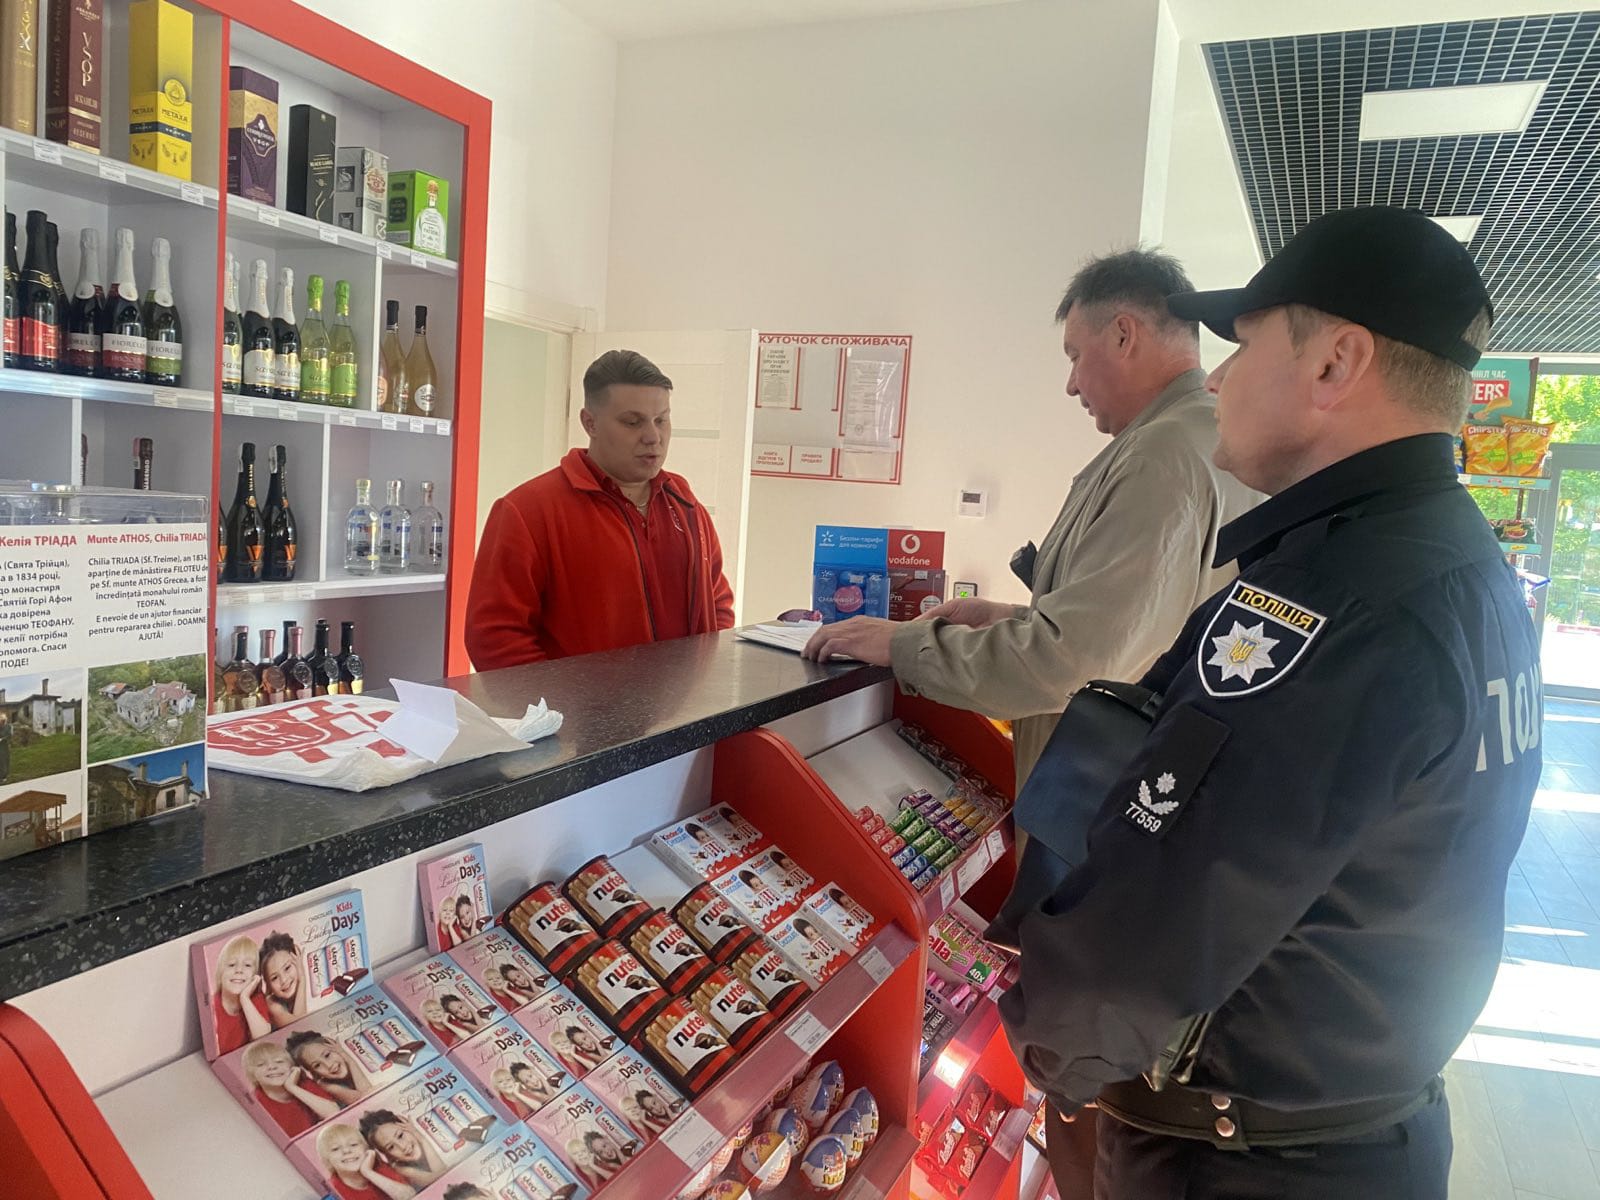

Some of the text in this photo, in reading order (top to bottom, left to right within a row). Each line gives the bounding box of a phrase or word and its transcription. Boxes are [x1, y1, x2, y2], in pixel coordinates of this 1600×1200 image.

[758, 335, 908, 346] КУТОЧОК СПОЖИВАЧА
[1473, 383, 1505, 401] ERS
[34, 535, 77, 547] ТРІАДА
[87, 534, 118, 544] Munte
[119, 534, 153, 543] ATHOS,
[154, 533, 179, 542] Chilia
[4, 560, 33, 570] (Свята
[88, 557, 110, 566] Chilia
[112, 556, 140, 564] TRIADA
[173, 564, 201, 572] FILOTEU
[888, 557, 931, 566] vodafone
[16, 572, 37, 581] 1834
[113, 579, 137, 587] munte
[138, 577, 162, 586] ATHOS
[11, 584, 61, 593] монастиря
[142, 587, 180, 596] monahului
[29, 595, 47, 606] Горі
[48, 595, 72, 604] Афон
[136, 599, 167, 608] TEOFAN.
[10, 608, 51, 619] довірена
[102, 613, 128, 622] nevoie
[129, 611, 139, 619] de
[140, 610, 149, 618] un
[150, 608, 171, 619] ajutor
[172, 606, 202, 616] financiar
[1237, 588, 1314, 630] ПОЛІЦІЯ
[31, 617, 75, 629] ТЕОФАНУ.
[88, 627, 115, 637] pentru
[116, 622, 151, 633] repararea
[152, 619, 173, 628] chiliei
[4, 629, 68, 643] келії потрібна
[41, 643, 67, 652] Спаси
[1125, 801, 1162, 832] 77559
[459, 863, 481, 880] Days
[336, 902, 353, 913] Kids
[331, 911, 361, 933] Days
[486, 938, 513, 954] Days
[427, 966, 456, 984] Days
[968, 968, 985, 983] 40x
[355, 1000, 389, 1020] Days
[551, 998, 576, 1016] Days
[495, 1031, 523, 1051] Days
[619, 1059, 644, 1079] Days
[424, 1071, 458, 1095] Days
[567, 1098, 595, 1120] Days
[503, 1132, 522, 1147] Kids
[505, 1138, 537, 1164] Days
